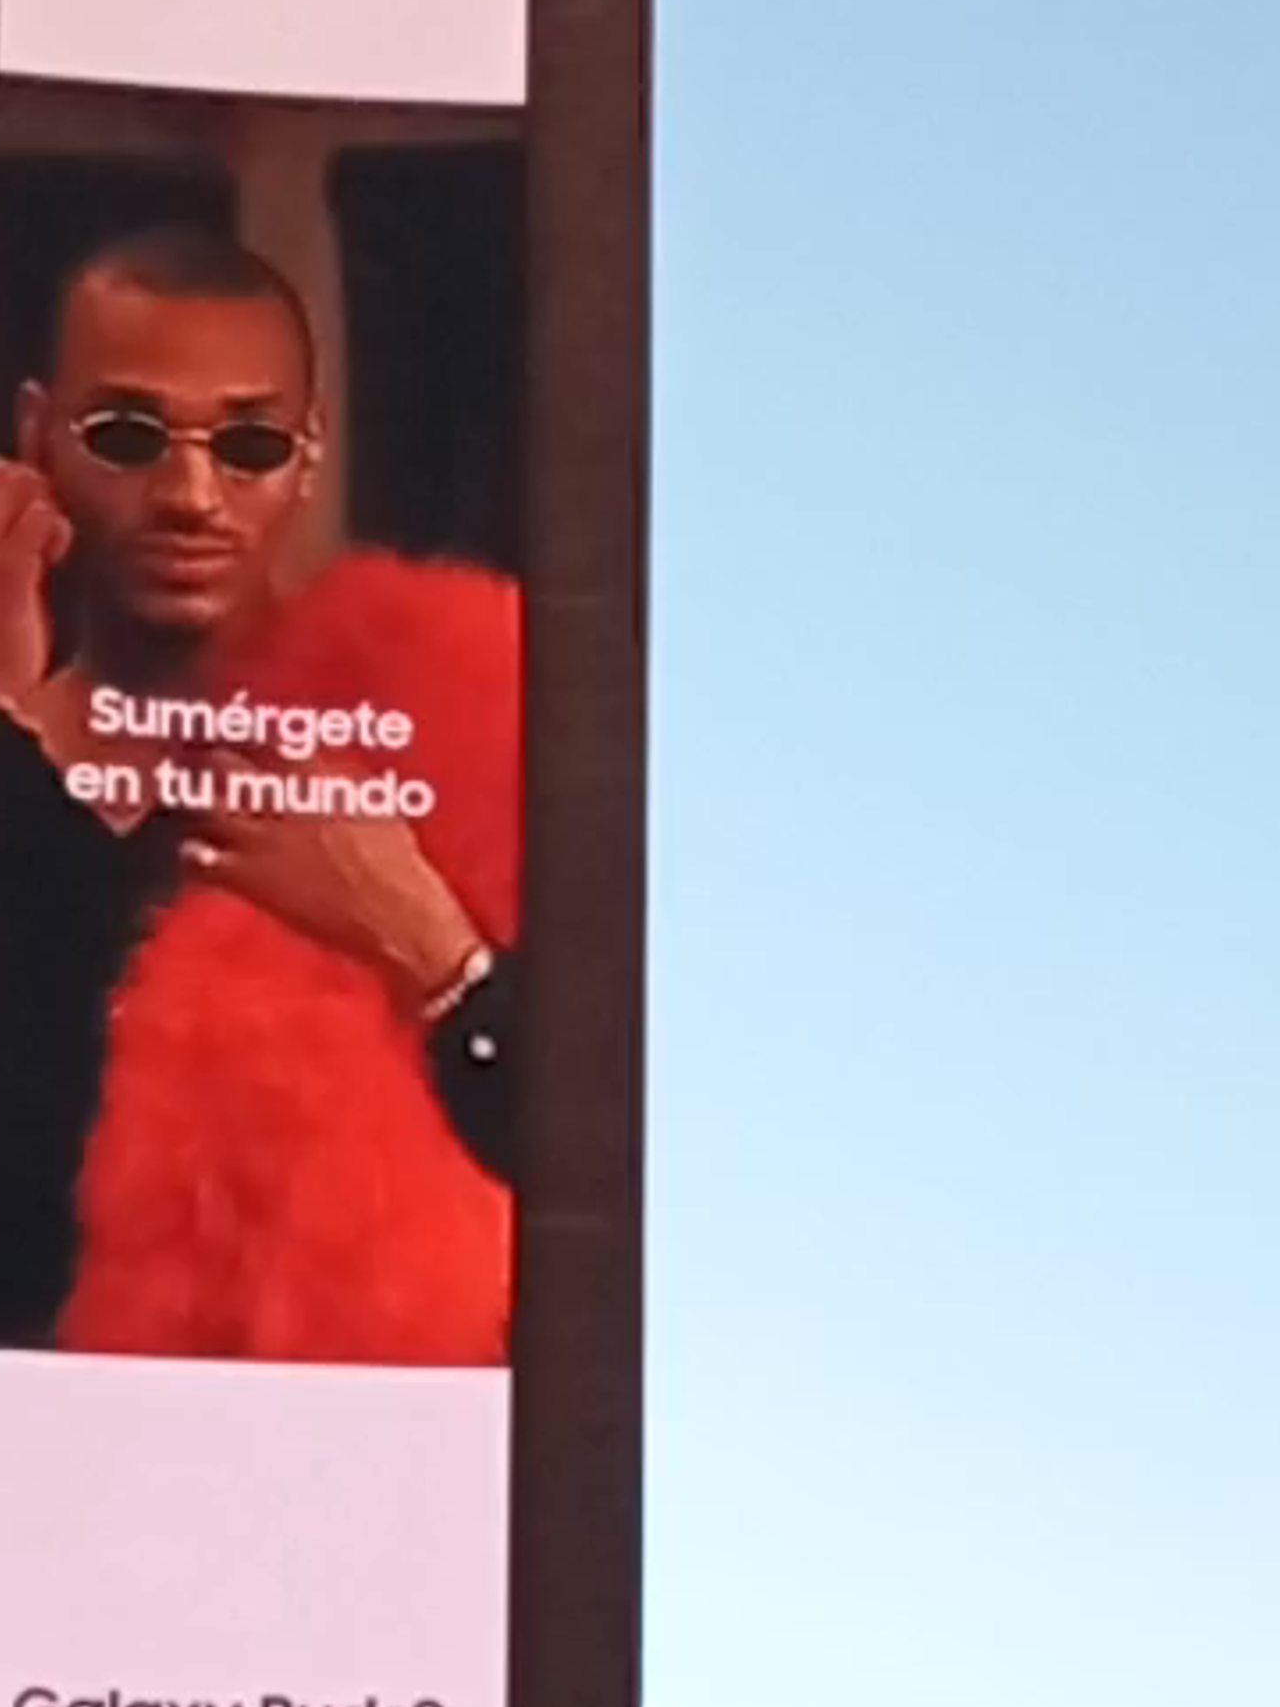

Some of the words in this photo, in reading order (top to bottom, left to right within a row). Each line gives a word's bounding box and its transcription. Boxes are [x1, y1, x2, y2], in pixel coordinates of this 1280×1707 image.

[88, 687, 413, 760] Sumérgete
[65, 760, 140, 802] en
[154, 758, 214, 809] tu
[227, 770, 436, 818] mundo
